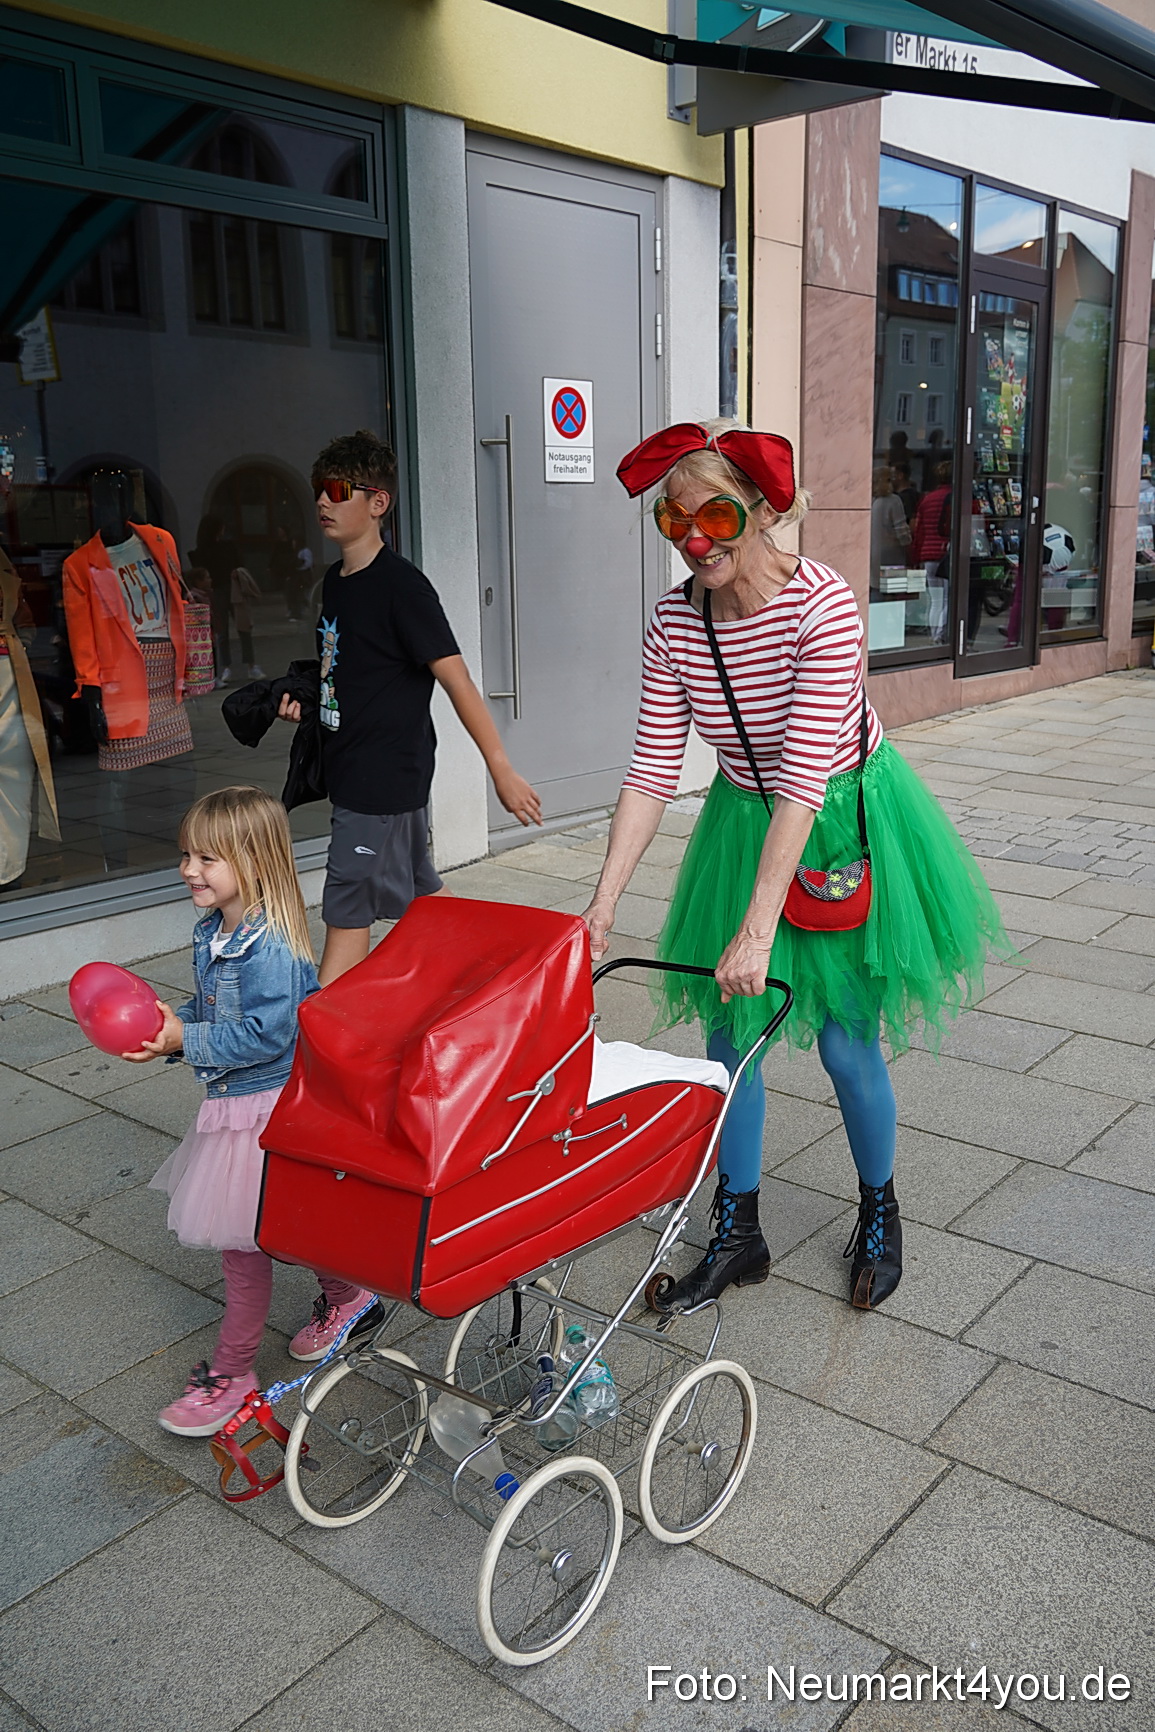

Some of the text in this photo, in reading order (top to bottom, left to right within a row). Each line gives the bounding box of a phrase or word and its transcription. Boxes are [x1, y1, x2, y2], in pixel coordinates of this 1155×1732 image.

[915, 35, 957, 71] Markt
[962, 52, 978, 74] 15
[548, 452, 592, 464] Notausgang
[553, 464, 588, 474] freihalten
